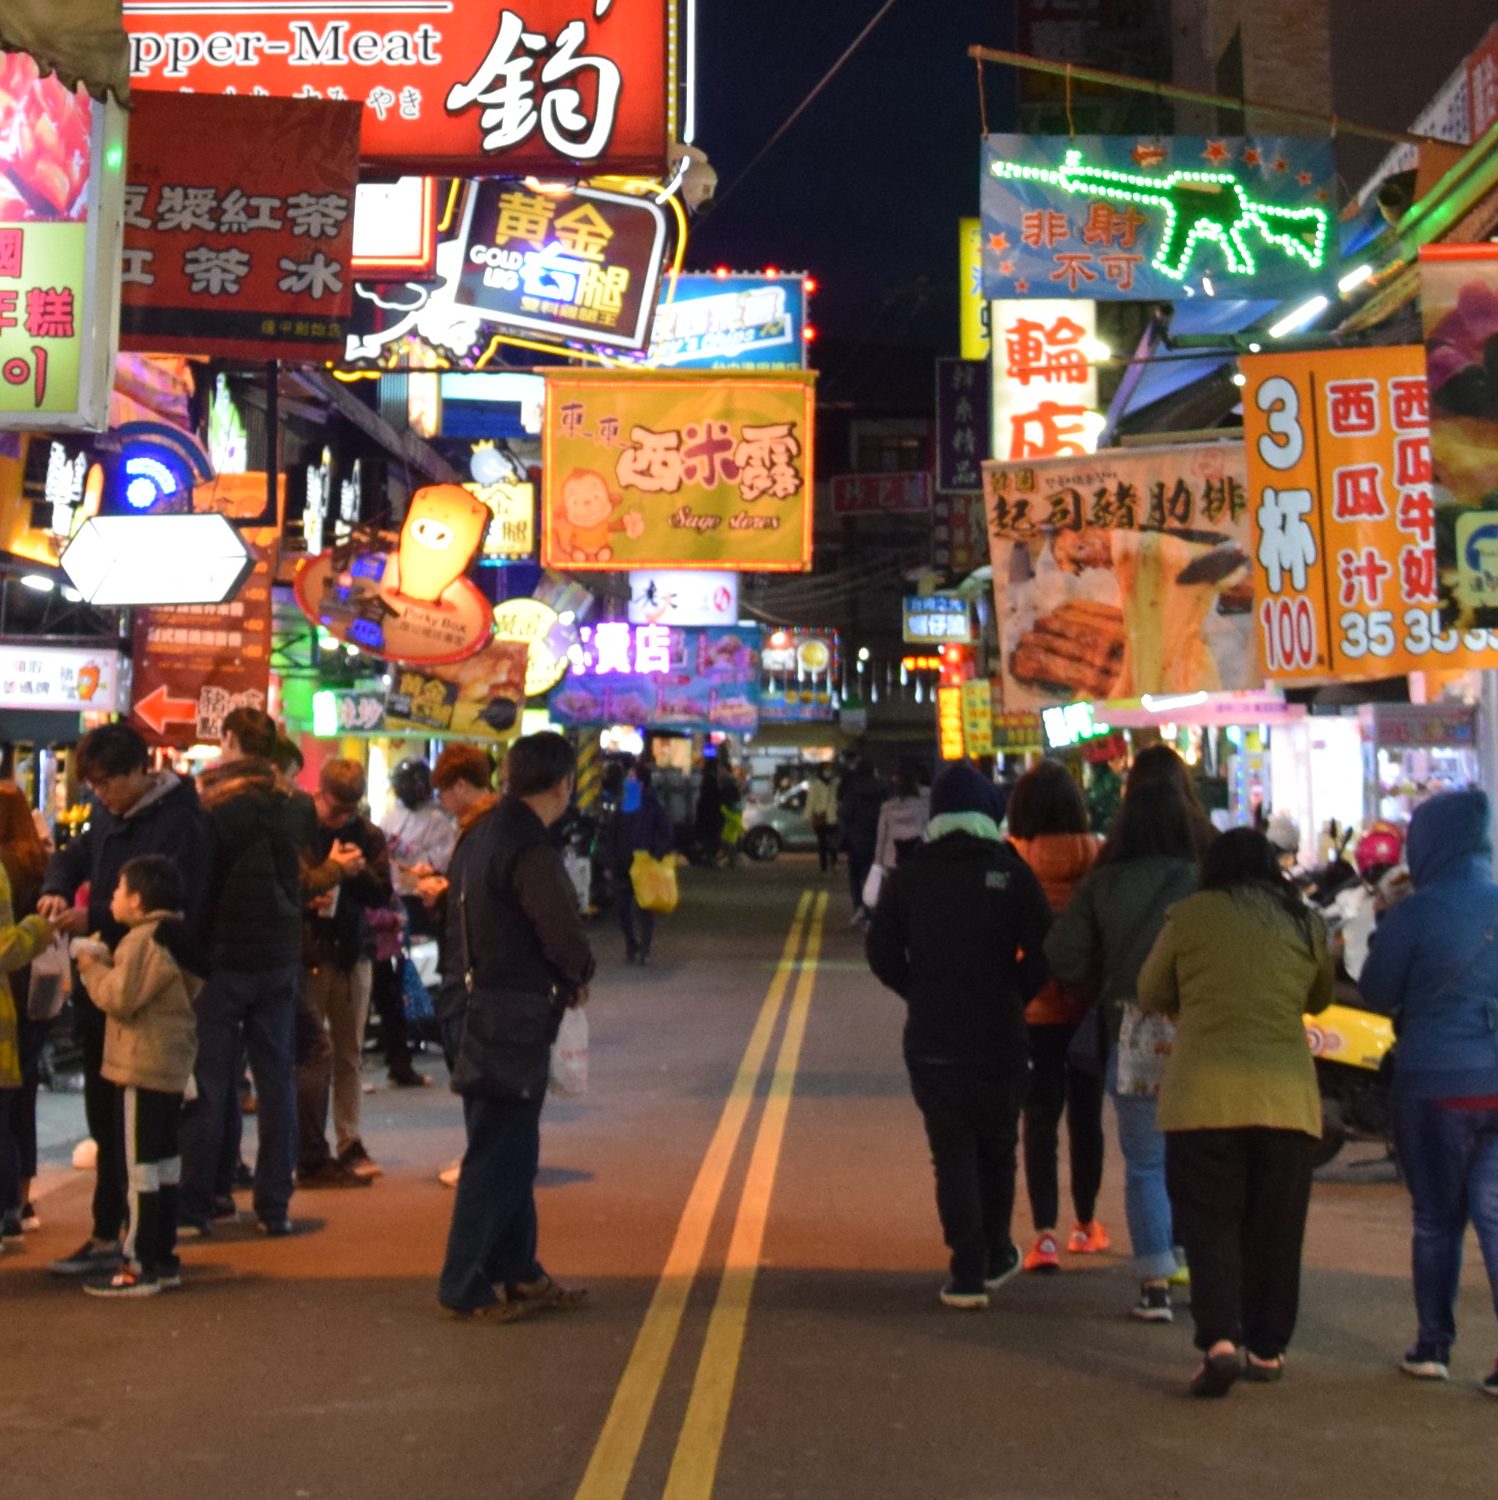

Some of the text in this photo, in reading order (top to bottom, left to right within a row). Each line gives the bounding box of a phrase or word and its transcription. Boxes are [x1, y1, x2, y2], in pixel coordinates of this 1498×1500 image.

[495, 192, 614, 263] 黃金
[1021, 203, 1146, 250] 非射
[470, 245, 523, 270] GOLD
[483, 268, 519, 292] LEG
[1049, 254, 1144, 293] 不可
[616, 419, 802, 501] 西米露
[1327, 378, 1397, 659] 西瓜汁 35
[1260, 598, 1316, 671] 100
